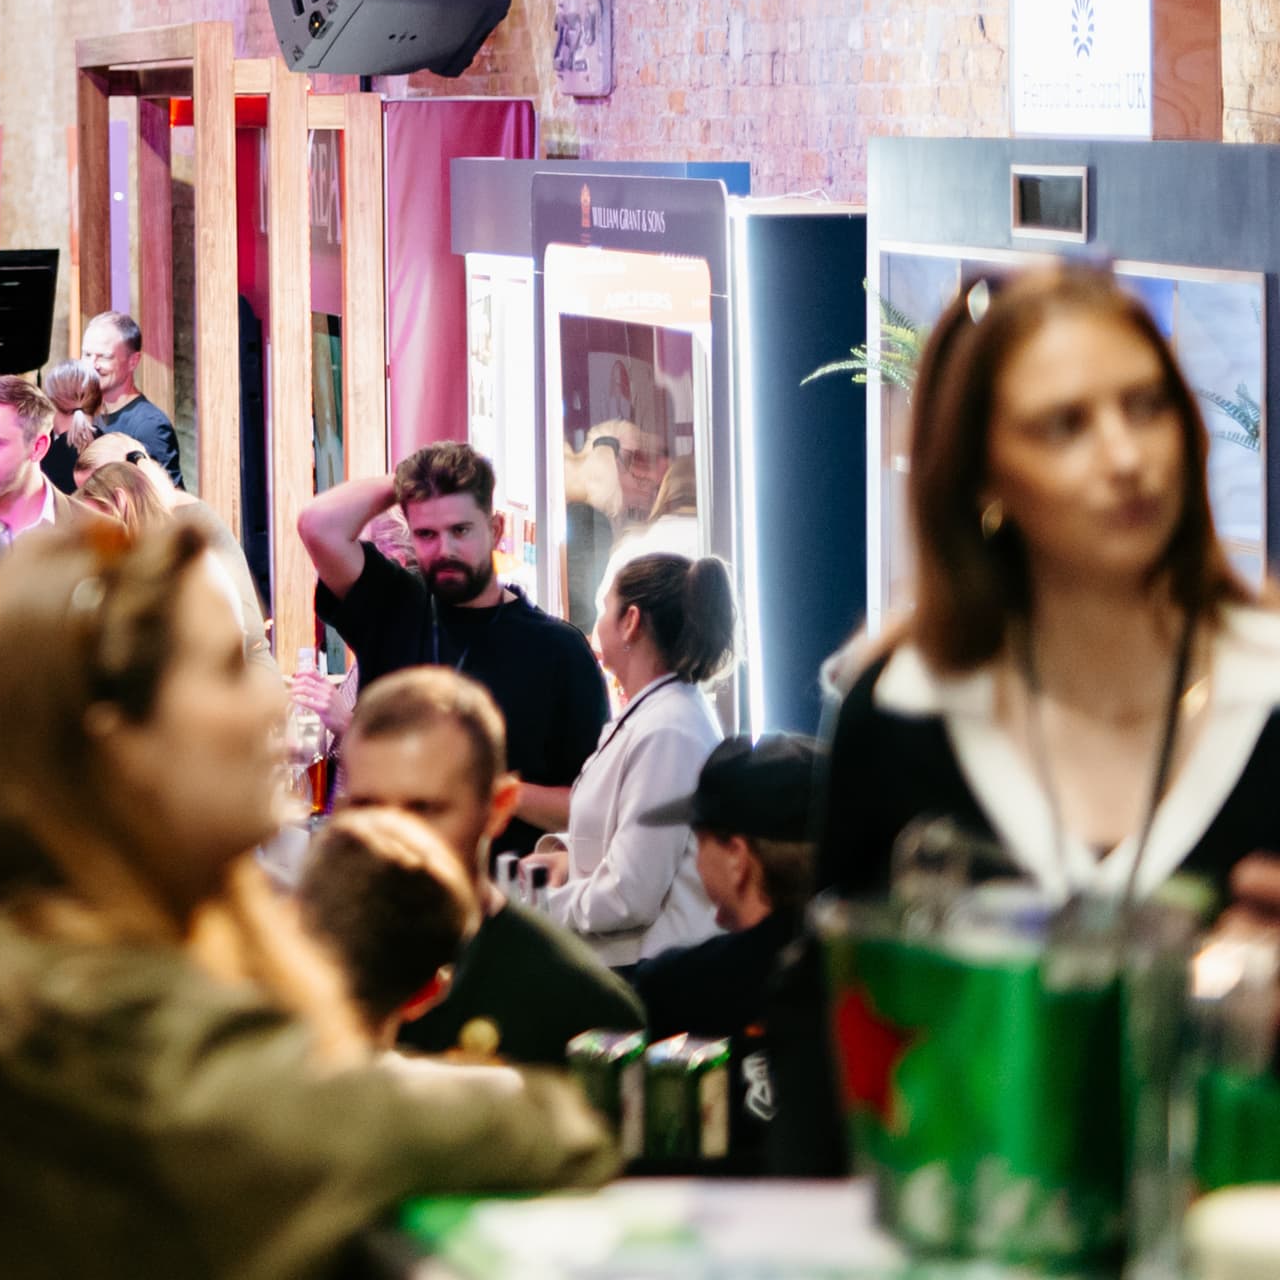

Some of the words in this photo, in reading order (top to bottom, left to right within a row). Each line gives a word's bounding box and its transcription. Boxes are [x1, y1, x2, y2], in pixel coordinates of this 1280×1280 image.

[1126, 72, 1147, 109] UK
[592, 207, 619, 230] WILLIAM
[620, 208, 640, 231] GRANT
[641, 210, 647, 232] &
[647, 210, 666, 234] SONS
